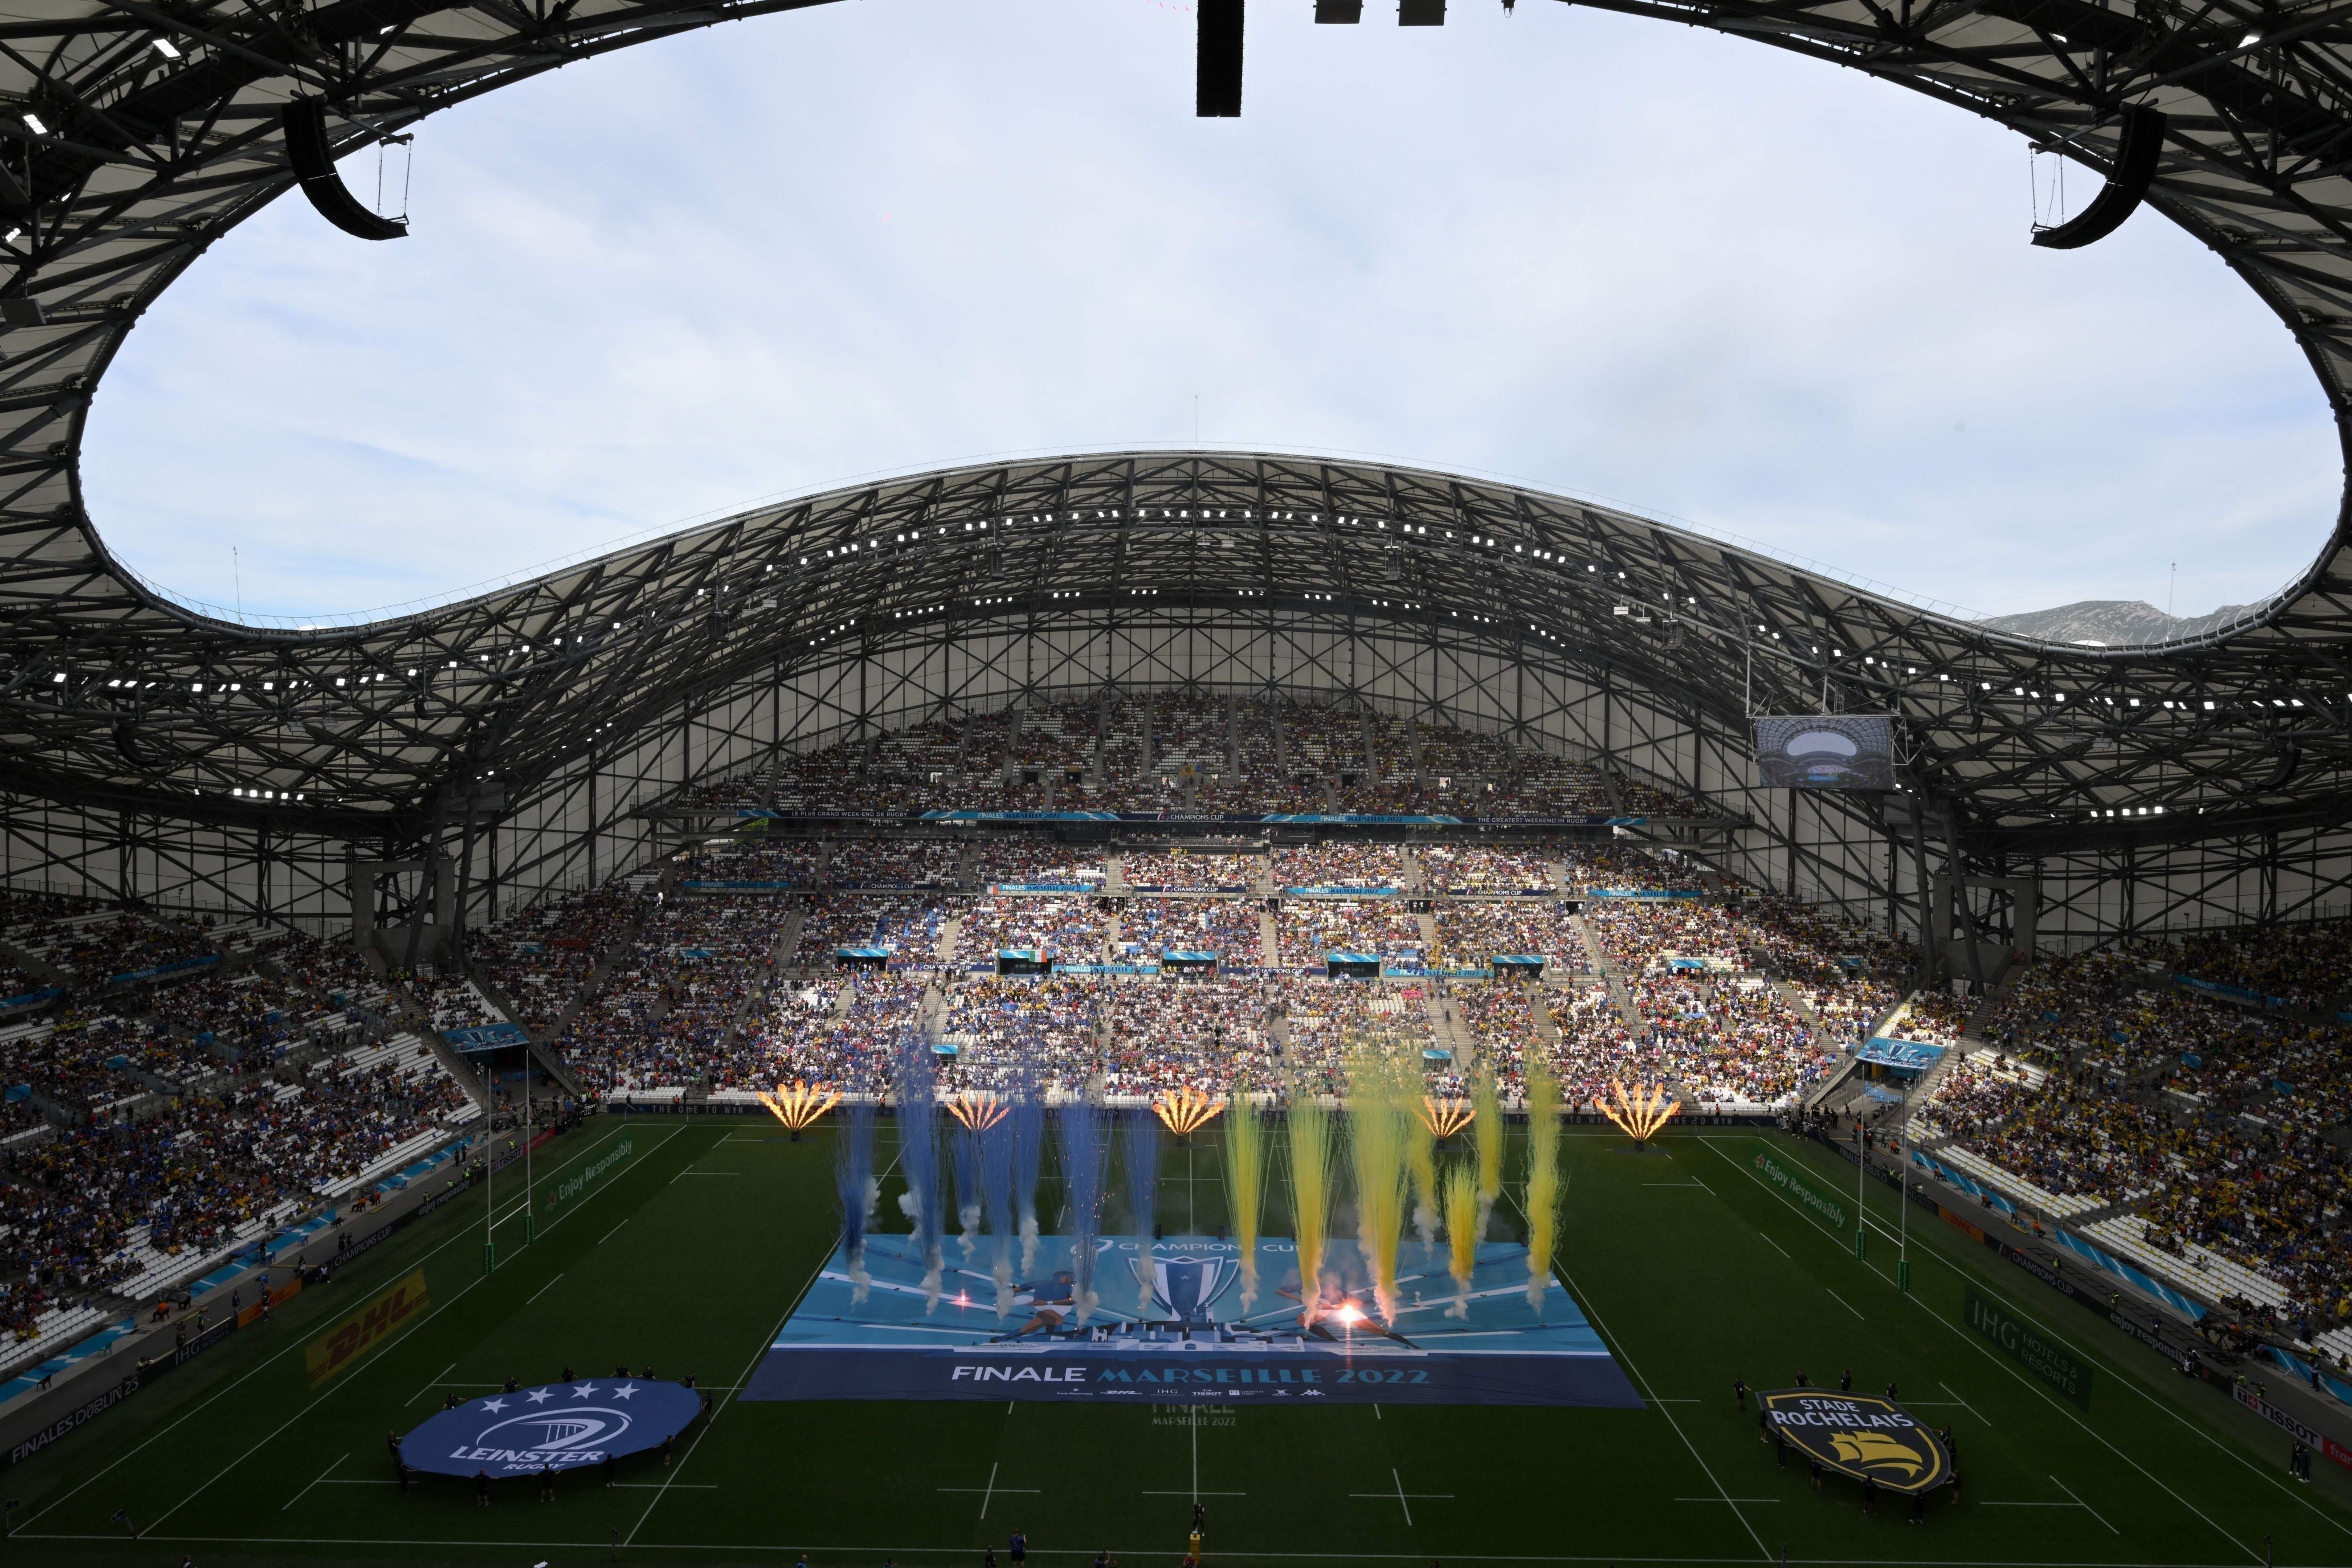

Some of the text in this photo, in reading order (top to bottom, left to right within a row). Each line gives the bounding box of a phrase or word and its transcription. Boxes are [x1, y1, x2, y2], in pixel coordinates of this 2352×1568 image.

[133, 969, 156, 978] FINALES
[2192, 979, 2215, 990] FINALES
[499, 1148, 521, 1167] TISSOT
[1839, 1146, 1861, 1167] FINALES
[559, 1174, 583, 1200] Enjoy
[586, 1140, 632, 1181] Responsibly
[419, 1179, 470, 1215] enjoy responsibly
[1765, 1160, 1845, 1227] Enjoy Responsibly
[1906, 1186, 1917, 1201] HG
[1950, 1212, 1973, 1235] DHL
[334, 1226, 391, 1267] CHAMPIONS CUP
[2012, 1252, 2073, 1295] CHAMPIONS CUP
[326, 1285, 414, 1371] DHL
[1974, 1300, 2017, 1350] IHG
[202, 1331, 228, 1350] RESORTS
[2110, 1313, 2187, 1363] enjoy responsib
[175, 1341, 199, 1366] IHG
[2023, 1333, 2078, 1379] HOTELS &
[951, 1366, 1431, 1384] FINALE MARSEILLE 2022
[2021, 1349, 2076, 1394] RESORTS
[1799, 1399, 1860, 1412] STADE
[12, 1376, 139, 1464] FINALES DUBLIN 23
[1152, 1416, 1236, 1426] MARSEILE 2022
[1770, 1411, 1914, 1427] ROCHELAIS
[2259, 1400, 2318, 1445] TISSOT
[449, 1446, 605, 1462] LEINSTER
